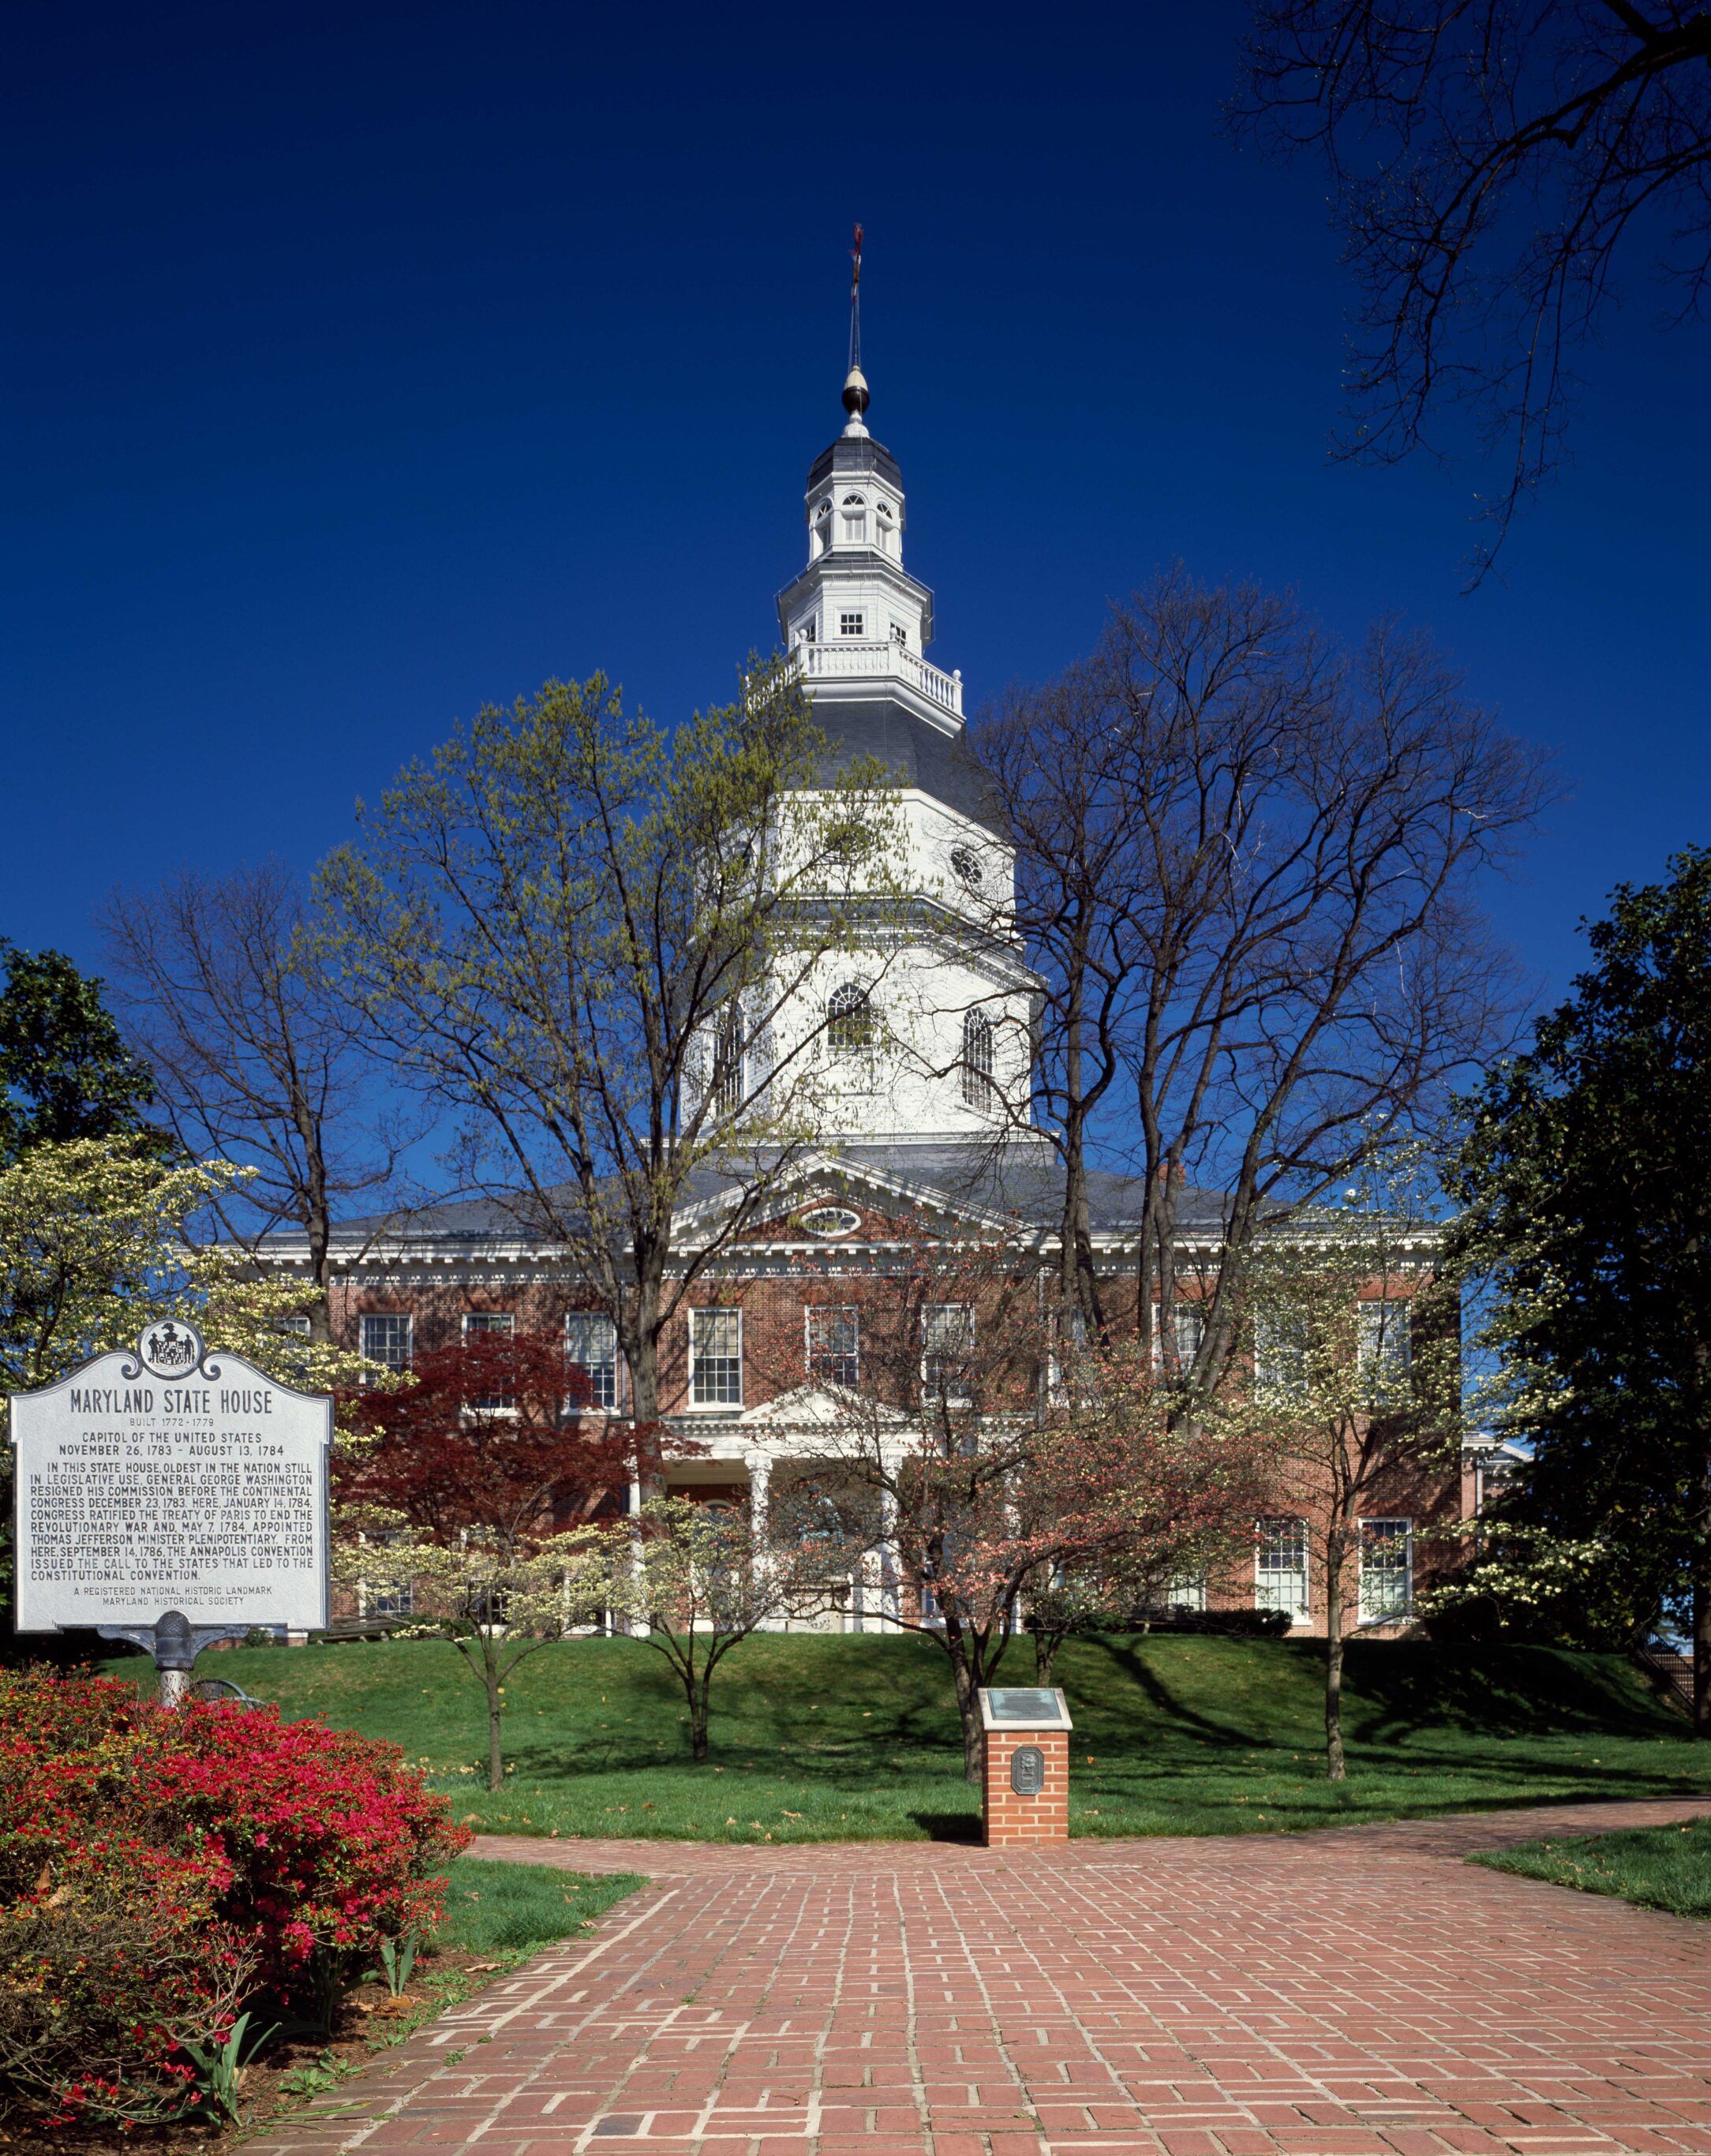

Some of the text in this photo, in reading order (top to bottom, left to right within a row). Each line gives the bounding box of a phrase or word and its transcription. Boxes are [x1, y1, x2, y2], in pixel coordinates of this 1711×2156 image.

[70, 1389, 272, 1413] MARYLAND STATE HOUSE
[82, 1432, 262, 1443] CAPITOL OF THE UNITED STATES
[59, 1445, 120, 1455] NOVEMBER
[148, 1445, 172, 1455] 1783
[189, 1446, 233, 1455] AUGUST
[259, 1445, 284, 1456] 1784
[47, 1462, 58, 1473] IN
[62, 1462, 86, 1473] THIS
[90, 1462, 122, 1473] STATE
[206, 1463, 216, 1473] IN
[220, 1463, 239, 1473] THE
[244, 1462, 280, 1473] NATION
[285, 1463, 313, 1473] STILL
[31, 1474, 41, 1484] IN
[47, 1474, 114, 1484] LEGISLATIVE
[147, 1474, 197, 1484] GENERAL
[200, 1475, 241, 1484] GEORGE
[246, 1475, 313, 1484] WASHINGTON
[31, 1486, 313, 1496] RESIGNED HIS COMMISSION BEFORE THE CONTINENTAL
[31, 1498, 84, 1508] CONGRESS
[89, 1498, 141, 1508] DECEMBER
[223, 1498, 270, 1508] JANUARY
[31, 1510, 313, 1520] CONGRESS RATIFIED THE TREATY OF PARIS TO END THE
[31, 1522, 120, 1533] REVOLUTIONARY
[125, 1522, 148, 1533] WAR
[182, 1522, 203, 1532] MAY
[253, 1522, 313, 1532] APPOINTED
[31, 1534, 72, 1544] THOMAS
[75, 1534, 133, 1544] JEFFERSON
[138, 1533, 185, 1544] MINISTER
[285, 1534, 313, 1544] FROM
[167, 1546, 186, 1556] THE
[190, 1546, 246, 1556] ANNAPOLIS
[251, 1546, 313, 1556] CONVENTION
[31, 1558, 313, 1569] ISSUED THE CALL TO THE STATES THAT LED TO THE
[31, 1570, 125, 1581] CONSTITUTIONAL
[208, 1596, 245, 1605] SOCIETY
